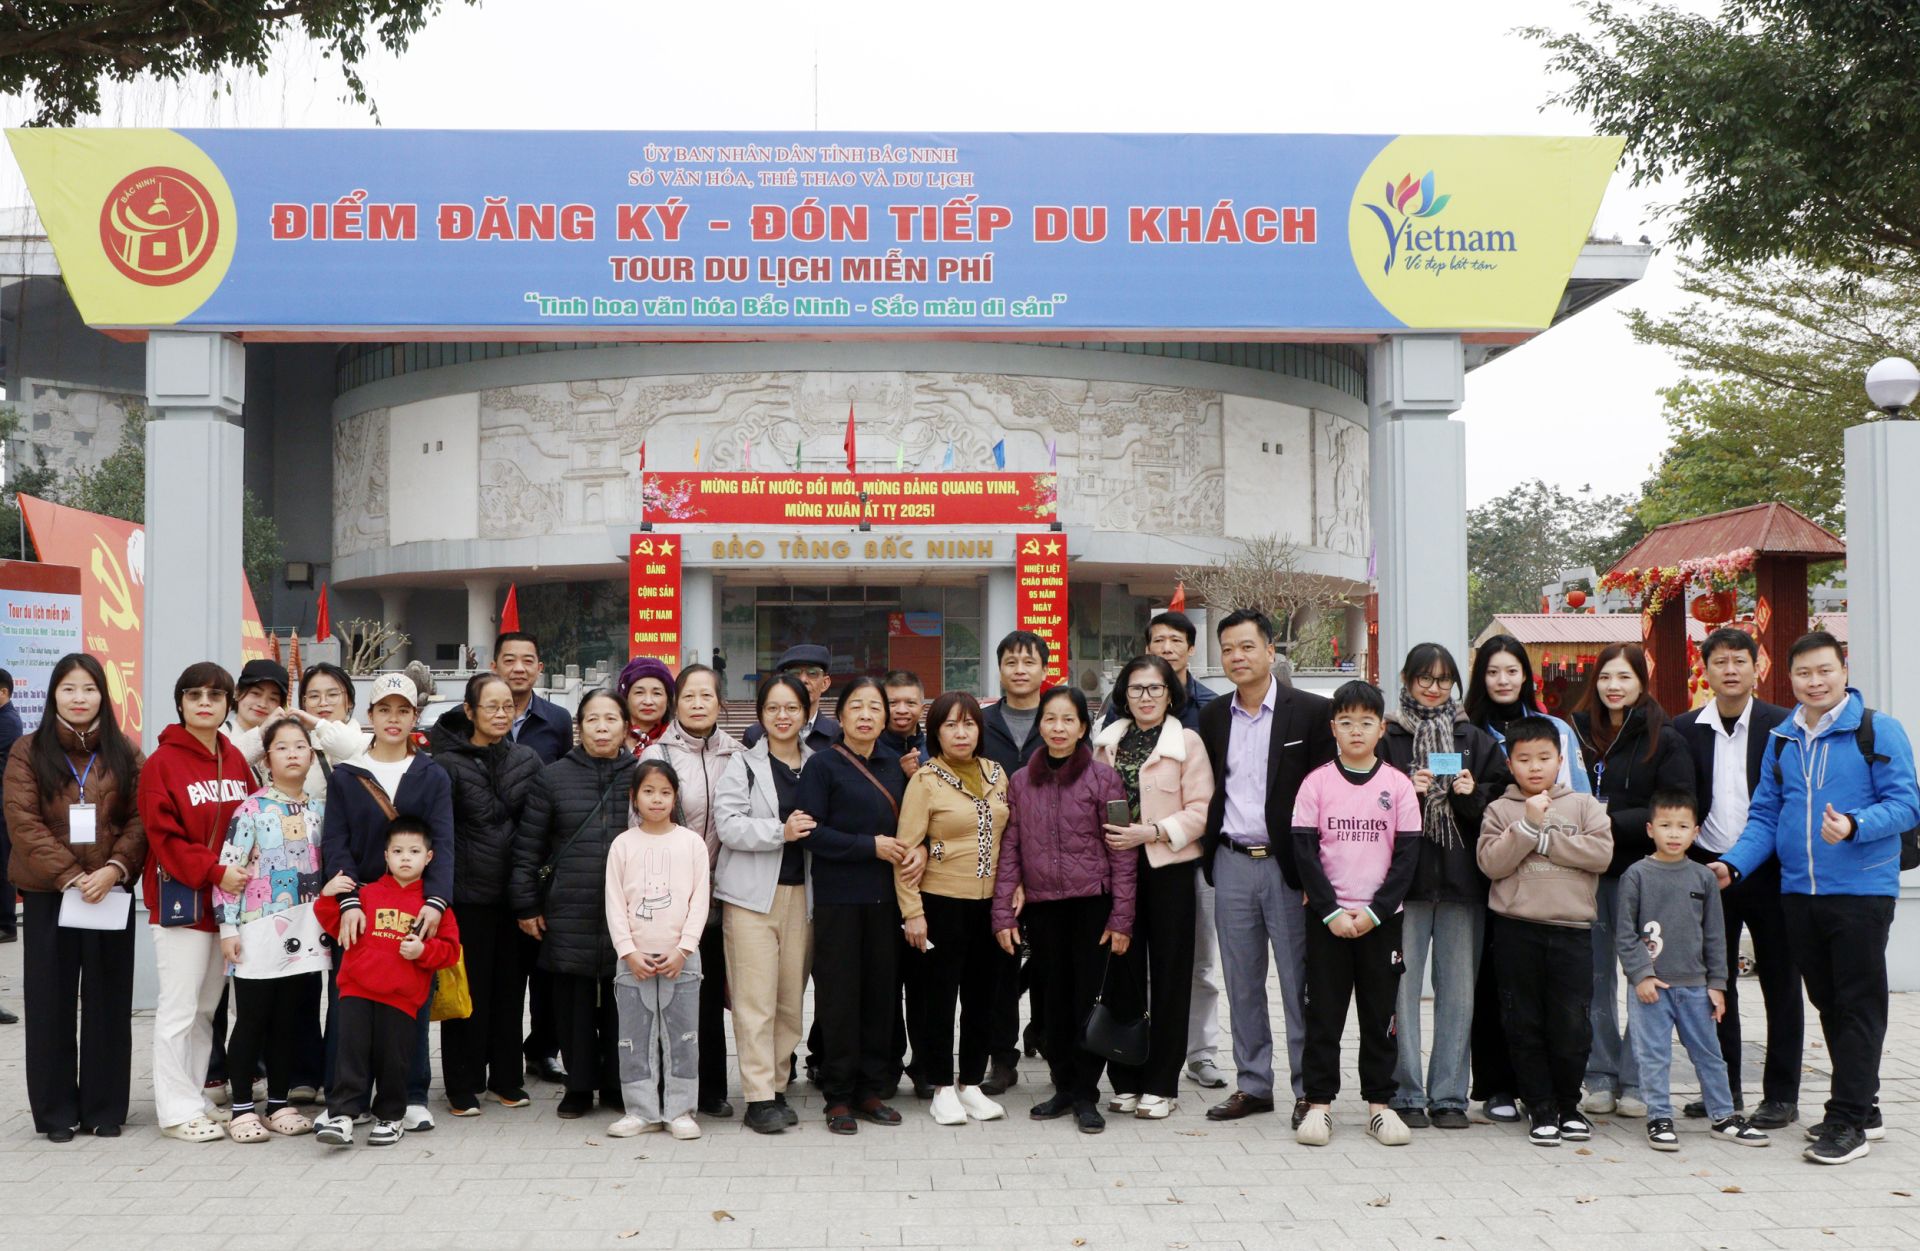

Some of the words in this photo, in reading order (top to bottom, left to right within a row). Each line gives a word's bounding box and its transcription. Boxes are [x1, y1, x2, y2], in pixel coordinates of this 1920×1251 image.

[643, 143, 672, 162] ỦY
[674, 146, 714, 162] BAN
[718, 143, 772, 162] NHÂN
[775, 143, 816, 162] DÂN
[820, 144, 865, 162] TỈNH
[868, 143, 907, 163] BẮC
[910, 147, 958, 163] NINH
[135, 177, 156, 191] NINH
[628, 167, 654, 186] SỞ
[658, 168, 701, 186] VĂN
[706, 168, 755, 188] HÓA,
[758, 168, 798, 186] THỂ
[801, 171, 857, 187] THAO
[860, 168, 890, 187] VÀ
[893, 172, 923, 187] DU
[926, 171, 975, 190] LỊCH
[269, 189, 418, 241] ĐIỂM
[436, 196, 597, 241] ĐĂNG
[616, 196, 690, 242] KÝ
[708, 219, 732, 233] -
[748, 197, 869, 243] ĐÓN
[887, 195, 1013, 244] TIẾP
[1033, 205, 1108, 245] DU
[1128, 198, 1316, 244] KHÁCH
[1361, 203, 1517, 276] Vietnam
[609, 255, 695, 283] TOUR
[703, 256, 749, 283] DU
[758, 256, 832, 287] LỊCH
[841, 248, 928, 283] MIỄN
[937, 252, 994, 284] PHÍ
[592, 297, 638, 316] hoa
[643, 296, 686, 316] văn
[692, 296, 737, 316] hóa
[742, 293, 789, 316] Bắc
[794, 297, 849, 316] Ninh
[855, 303, 867, 312] -
[872, 294, 918, 316] Sắc
[924, 297, 977, 317] màu
[982, 297, 1005, 317] di
[700, 478, 738, 494] MỪNG
[741, 476, 766, 494] ĐẤT
[768, 478, 803, 495] NƯỚC
[806, 476, 828, 495] ĐỔI
[863, 479, 900, 495] MỪNG
[904, 477, 938, 495] ĐẢNG
[941, 480, 983, 496] QUANG
[986, 481, 1020, 496] VINH,
[784, 501, 822, 517] MỪNG
[825, 501, 860, 518] XUÂN
[900, 503, 935, 518] 2025!
[712, 533, 765, 559] BẢO
[778, 534, 850, 559] TÀNG
[864, 535, 913, 559] BẮC
[926, 539, 994, 559] NINH
[646, 562, 666, 574] ĐẢNG
[1024, 564, 1045, 574] NHIỆT
[1046, 564, 1060, 574] LIỆT
[1021, 576, 1040, 586] CHÀO
[638, 585, 658, 599] CỘNG
[659, 584, 674, 597] SẢN
[1029, 590, 1038, 598] 95
[1039, 590, 1056, 598] NĂM
[9, 603, 22, 618] Tour
[24, 604, 32, 618] du
[1033, 602, 1052, 611] NGÀY
[639, 608, 654, 621] VIỆT
[655, 610, 672, 620] NAM
[1024, 615, 1047, 624] THÀNH
[1048, 614, 1061, 626] LẬP
[634, 632, 658, 643] QUANG
[660, 632, 677, 642] VINH
[1327, 816, 1388, 831] Emirates
[1337, 831, 1350, 841] FLY
[1352, 832, 1380, 842] BETTER
